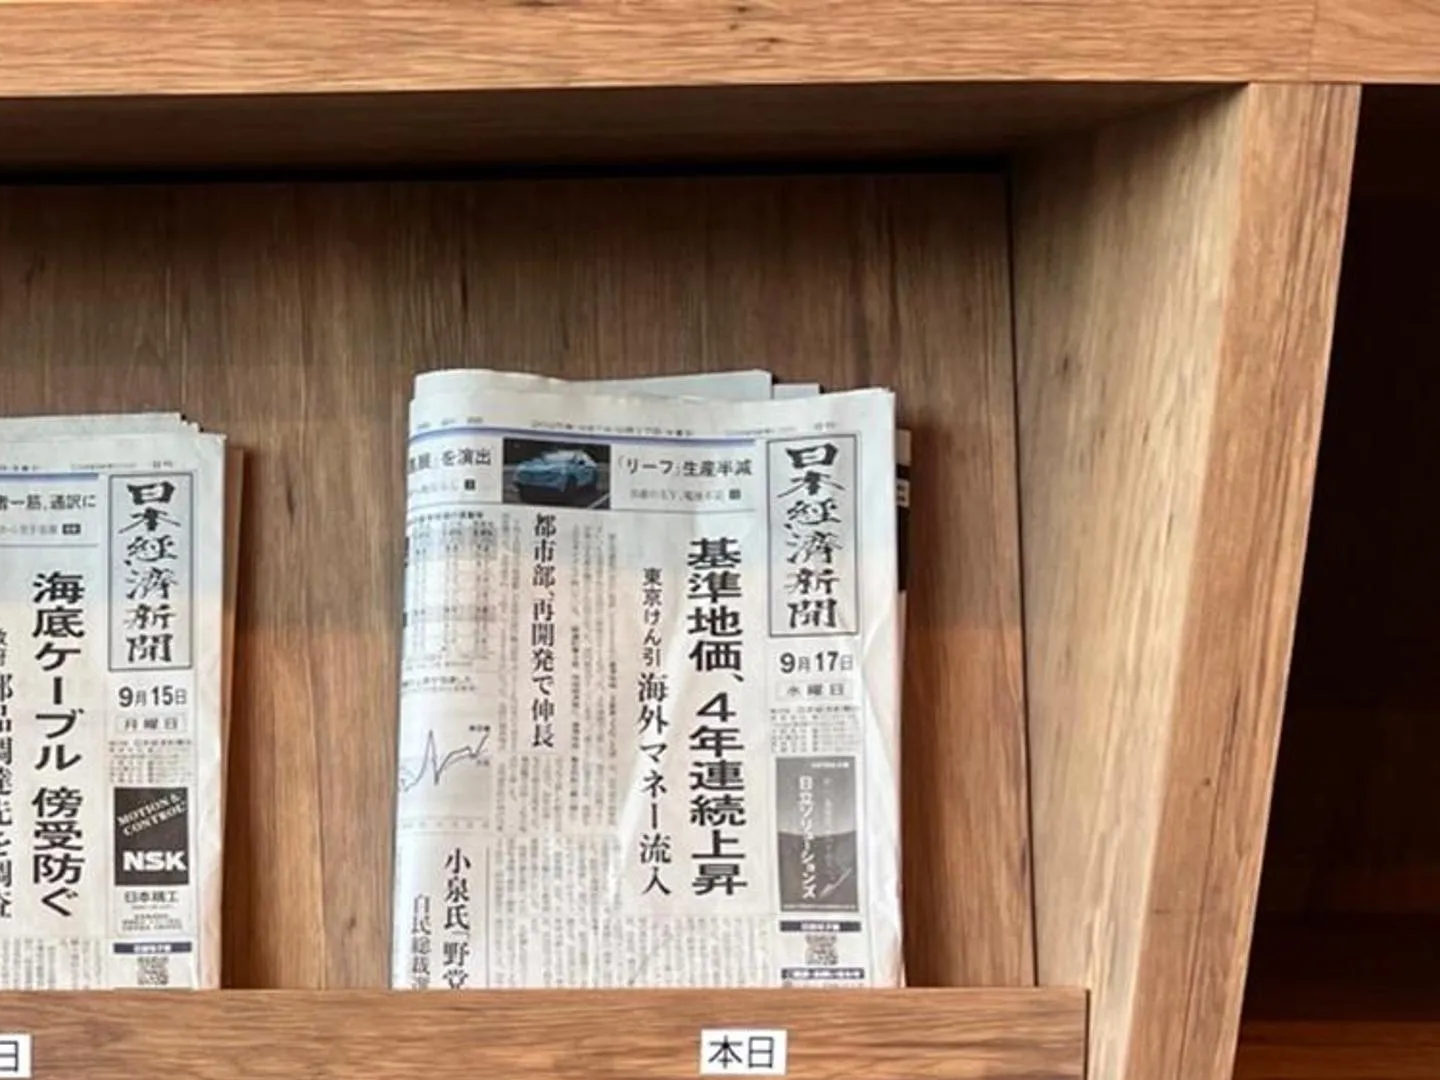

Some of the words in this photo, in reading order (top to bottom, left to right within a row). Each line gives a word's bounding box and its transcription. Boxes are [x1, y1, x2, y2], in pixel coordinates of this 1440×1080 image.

[532, 513, 557, 749] 都市部、再開発で伸長
[780, 651, 853, 675] 9月17日
[118, 685, 187, 708] 9月15日
[785, 683, 844, 696] 水曜日
[123, 717, 179, 731] 月曜日
[123, 852, 187, 872] NSK
[708, 1036, 777, 1068] 本日
